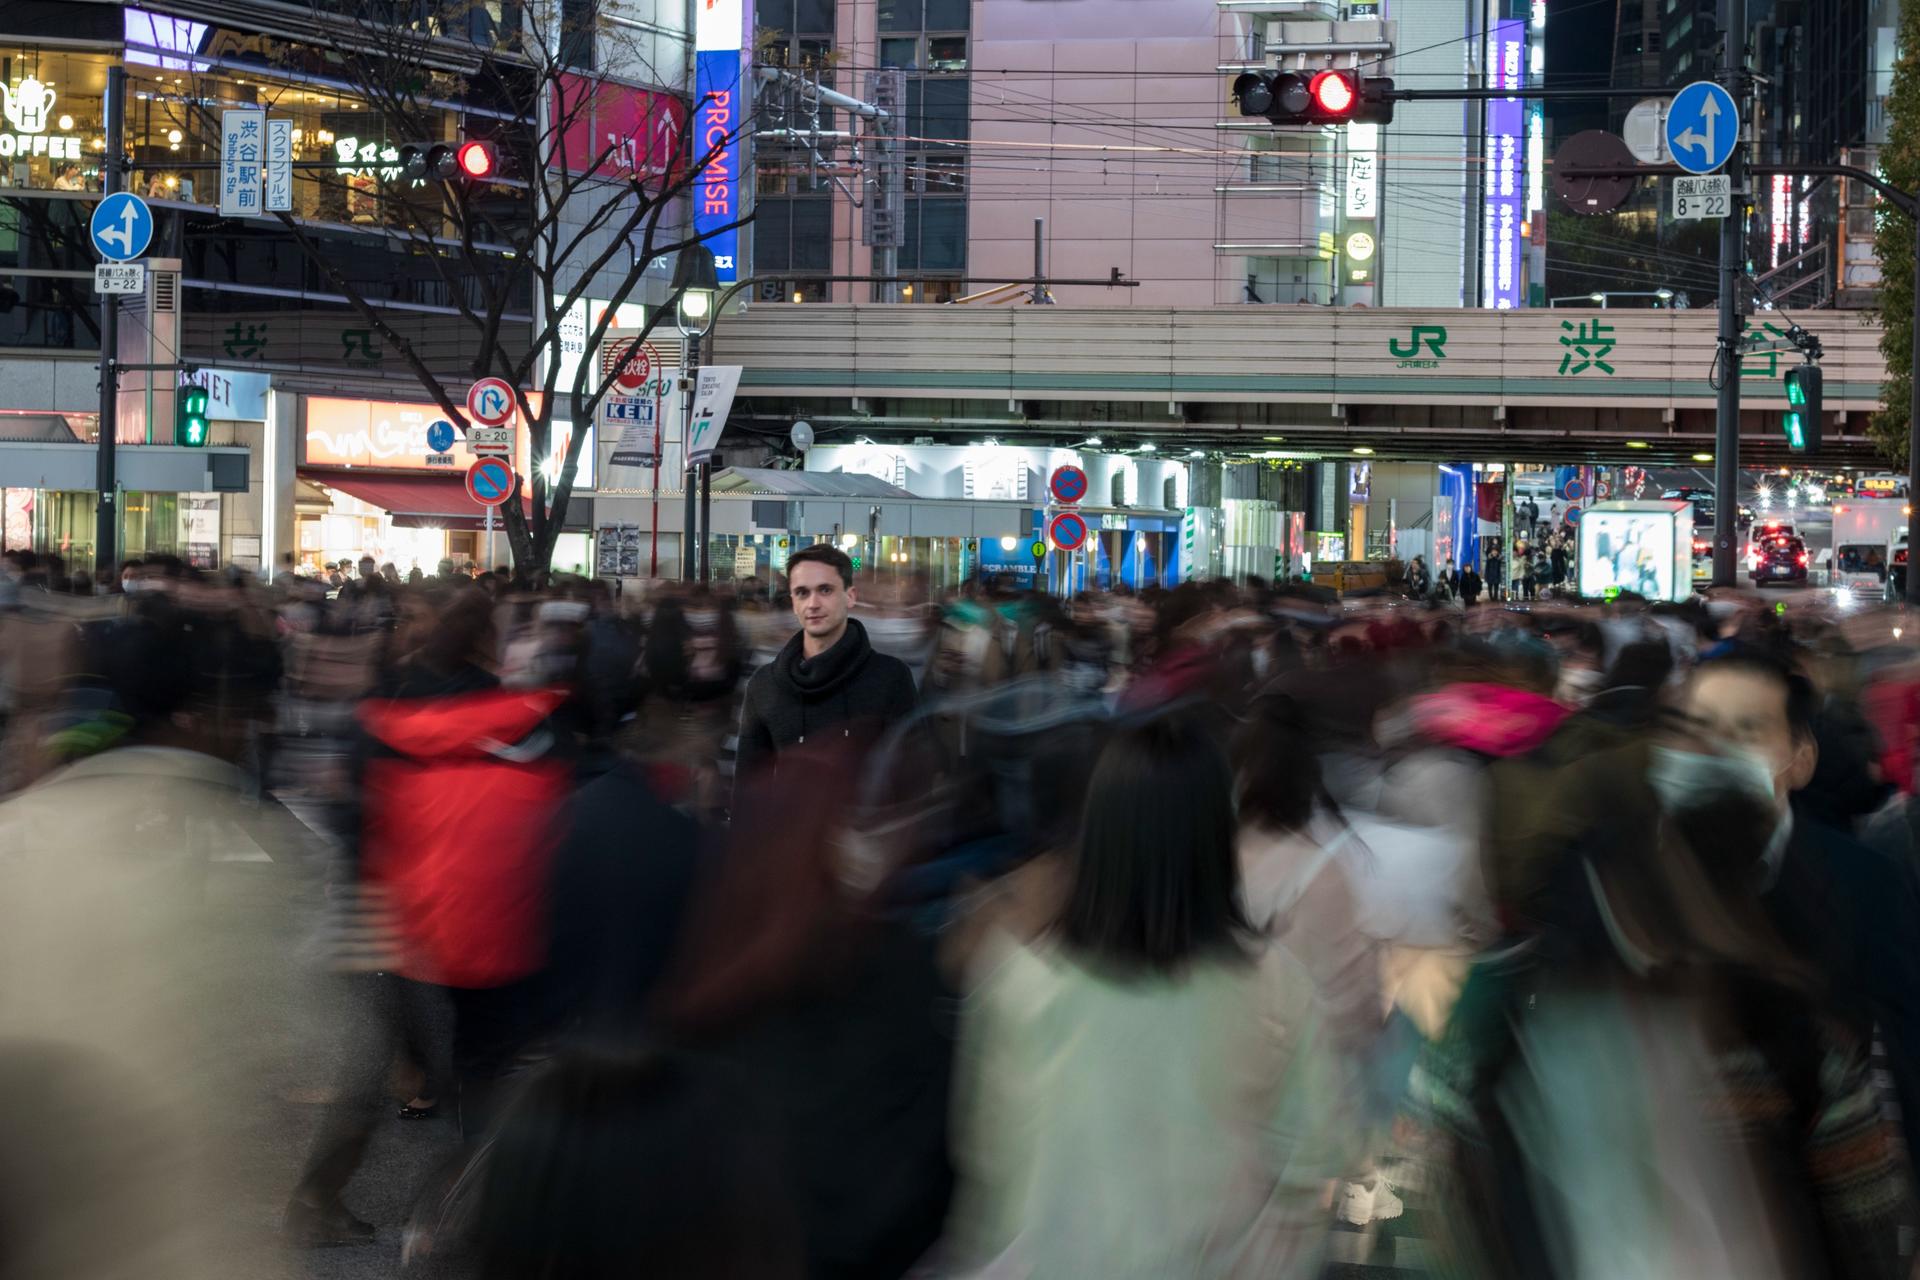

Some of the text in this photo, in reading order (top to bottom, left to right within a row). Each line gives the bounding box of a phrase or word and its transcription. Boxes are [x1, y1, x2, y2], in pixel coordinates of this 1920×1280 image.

[1356, 5, 1372, 14] 5F
[705, 91, 730, 215] PROMISE
[226, 133, 238, 197] Shibuya Sta.
[239, 120, 258, 207] 渋谷駅前
[1677, 178, 1727, 194] 路線バスを除く
[103, 279, 137, 290] 8-22
[1389, 325, 1447, 358] JR
[616, 359, 648, 376] 火栓
[1396, 359, 1440, 369] JR東日本
[609, 404, 650, 419] KEN
[982, 564, 1036, 573] SCRAMBLE
